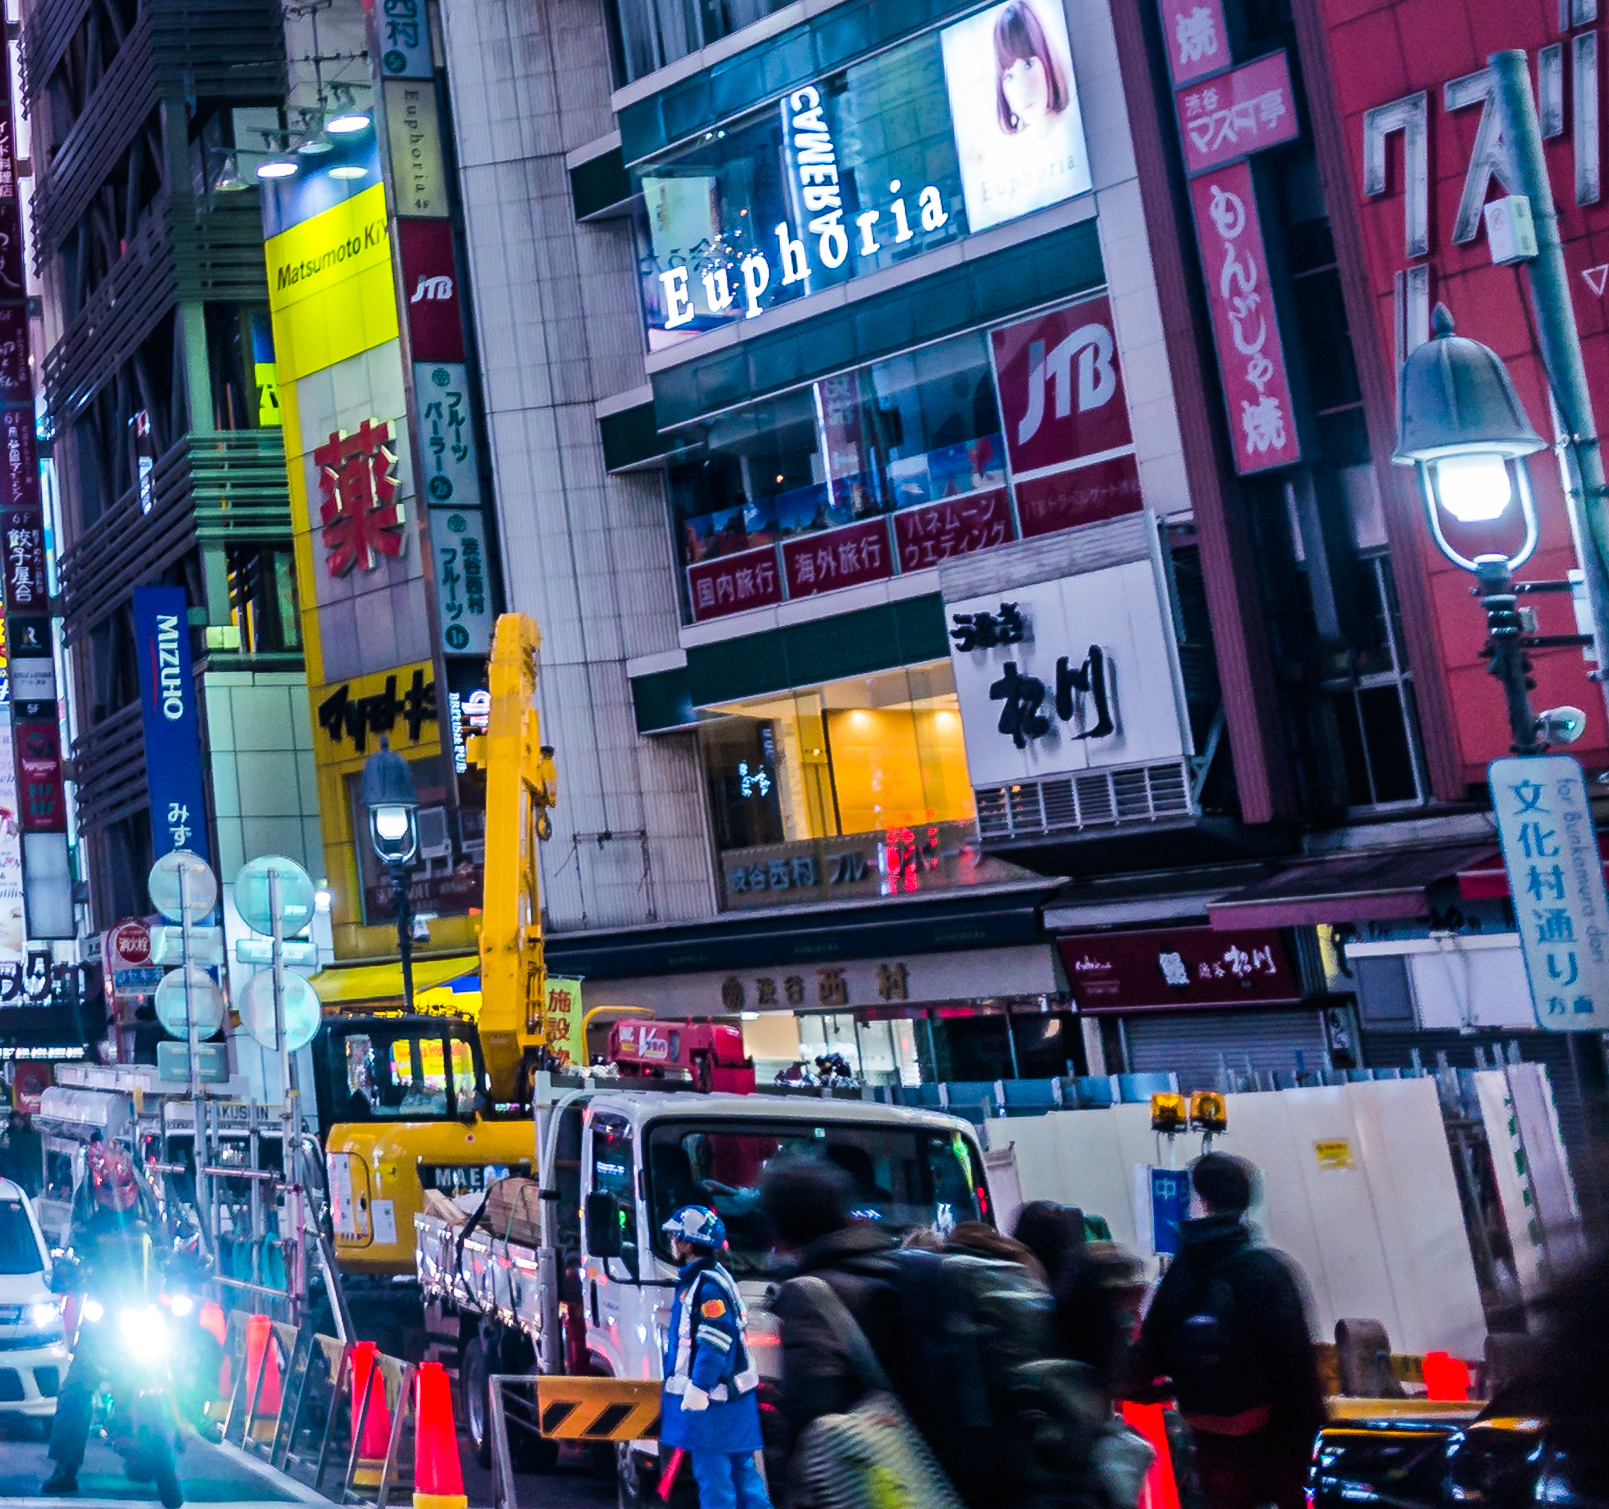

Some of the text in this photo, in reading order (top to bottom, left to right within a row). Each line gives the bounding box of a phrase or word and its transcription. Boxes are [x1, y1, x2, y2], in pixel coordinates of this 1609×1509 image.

[404, 90, 427, 195] Euphoria
[981, 152, 1077, 204] Euphoria
[277, 239, 362, 291] Matsumoto
[411, 275, 453, 303] JTB
[658, 179, 950, 330] Euphoria
[1209, 183, 1288, 455] もんじゃ焼
[1018, 322, 1118, 444] JTB
[424, 400, 446, 474] パーラー
[445, 391, 468, 463] フルーツ
[314, 417, 408, 578] 薬
[906, 497, 996, 539] ハネムーン
[6, 528, 34, 603] 餃子屋台
[441, 547, 466, 621] フルーツ
[460, 537, 484, 613] 渋谷西村
[696, 560, 775, 610] 国内旅行
[793, 534, 883, 583] 海外旅行
[154, 614, 184, 722] MIZUHO
[167, 802, 192, 853] みず
[1563, 811, 1596, 918] Bunkamura
[1507, 779, 1579, 987] 文化村通り
[117, 935, 151, 955] 消火栓
